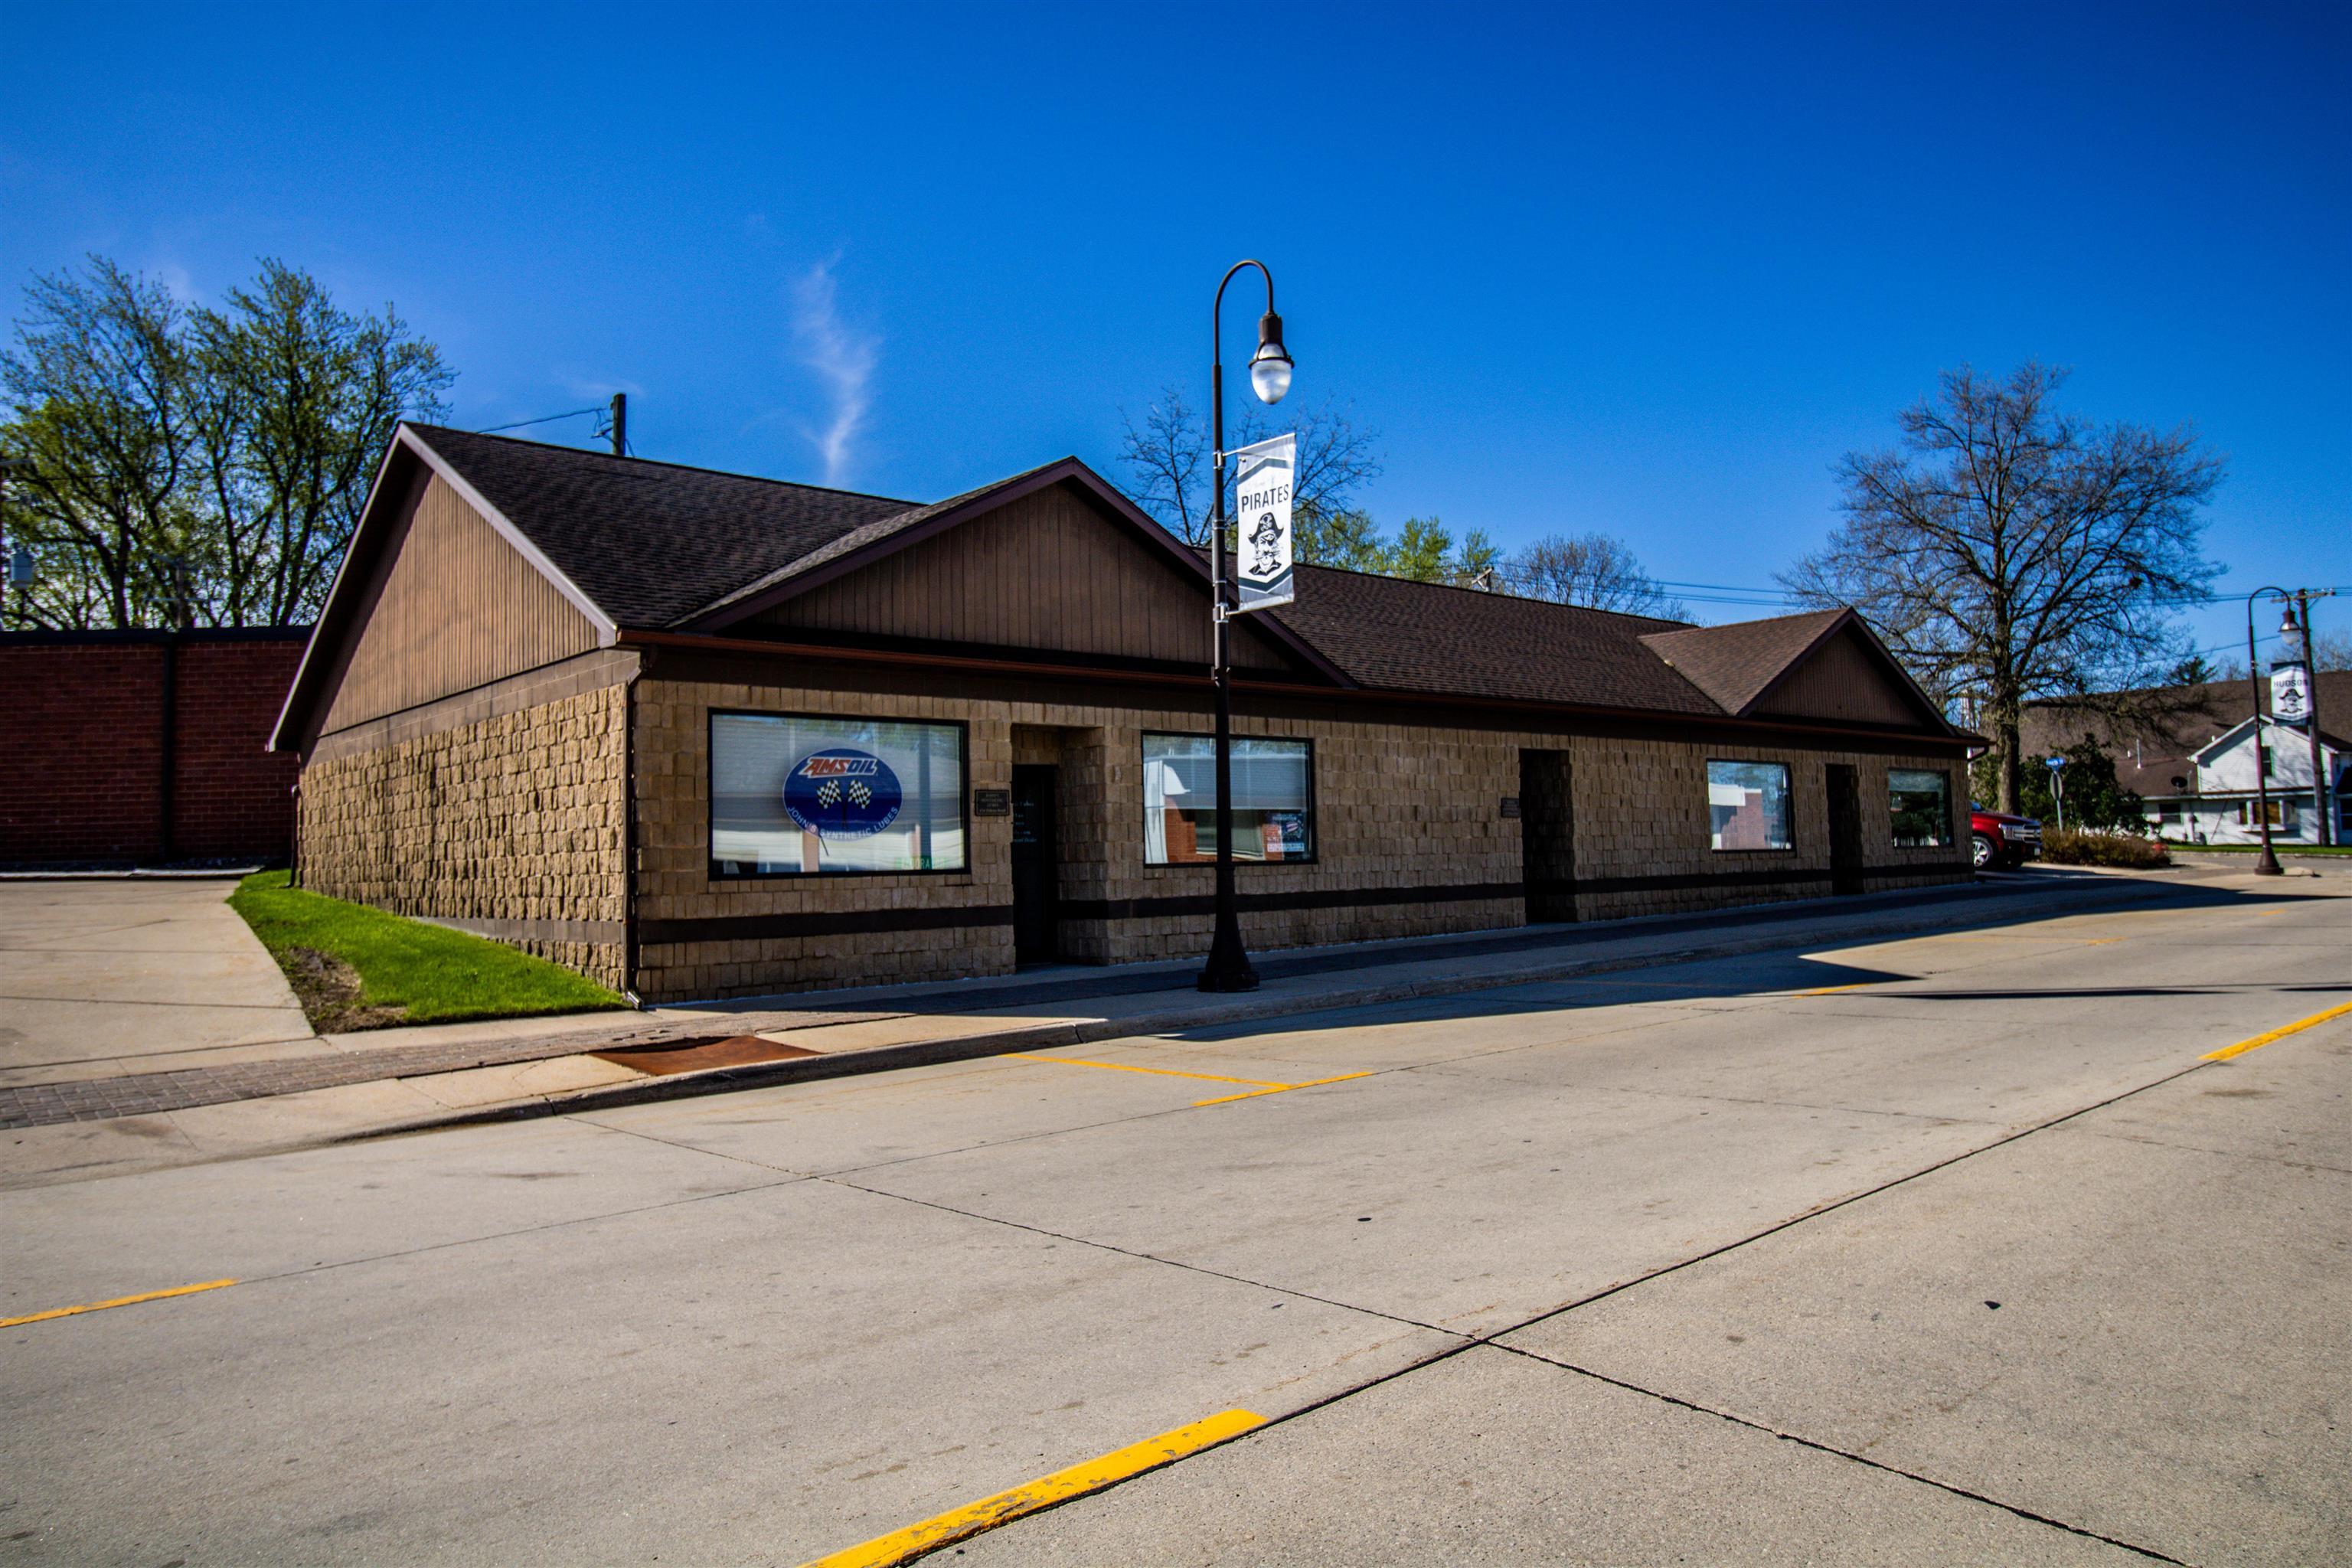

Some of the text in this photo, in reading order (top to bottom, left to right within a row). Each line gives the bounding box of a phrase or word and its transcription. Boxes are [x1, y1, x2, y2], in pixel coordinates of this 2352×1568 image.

[1241, 484, 1289, 512] PIRATES
[800, 757, 877, 778] AMSOIL
[788, 806, 898, 840] JOHN'S SYNTHETIC LUBES
